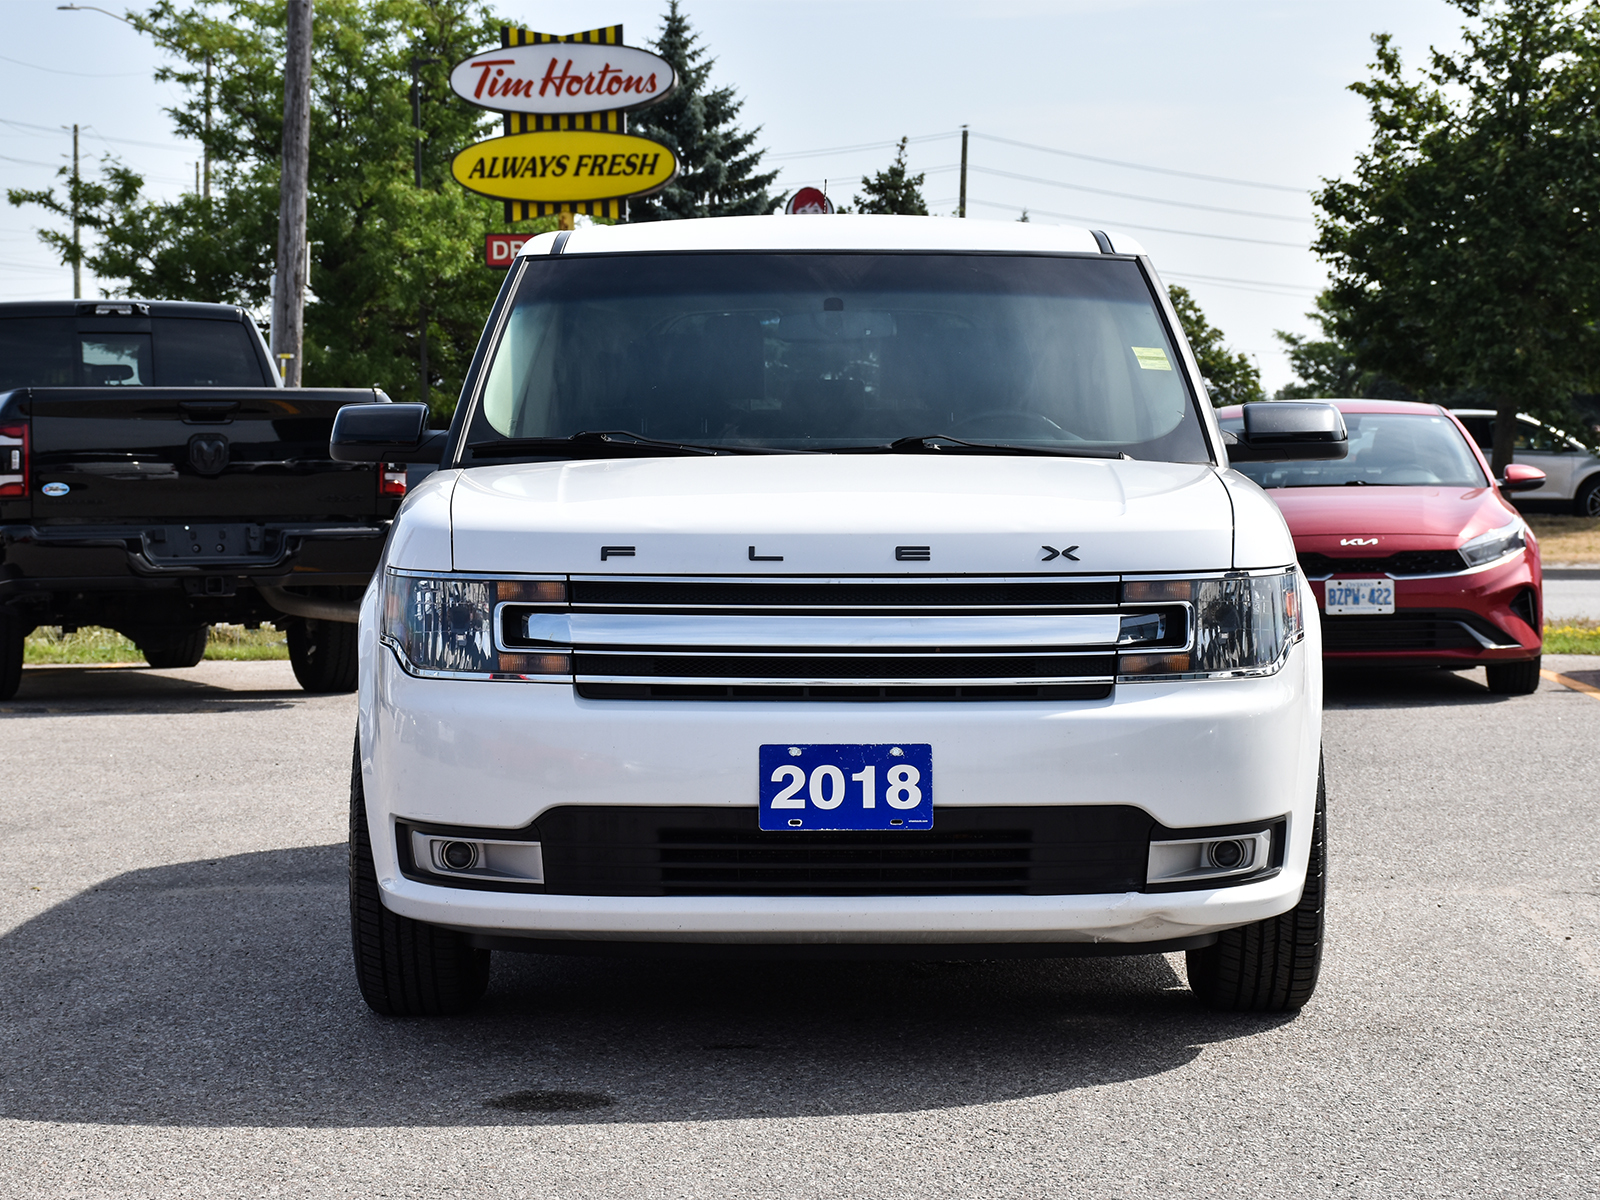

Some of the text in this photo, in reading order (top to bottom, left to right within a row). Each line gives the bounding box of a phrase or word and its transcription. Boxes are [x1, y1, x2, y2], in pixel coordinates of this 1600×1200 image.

[470, 57, 658, 100] Tim Hortons
[468, 153, 660, 179] ALWAYS FRESH
[600, 545, 1080, 562] FLEX
[770, 764, 922, 810] 2018
